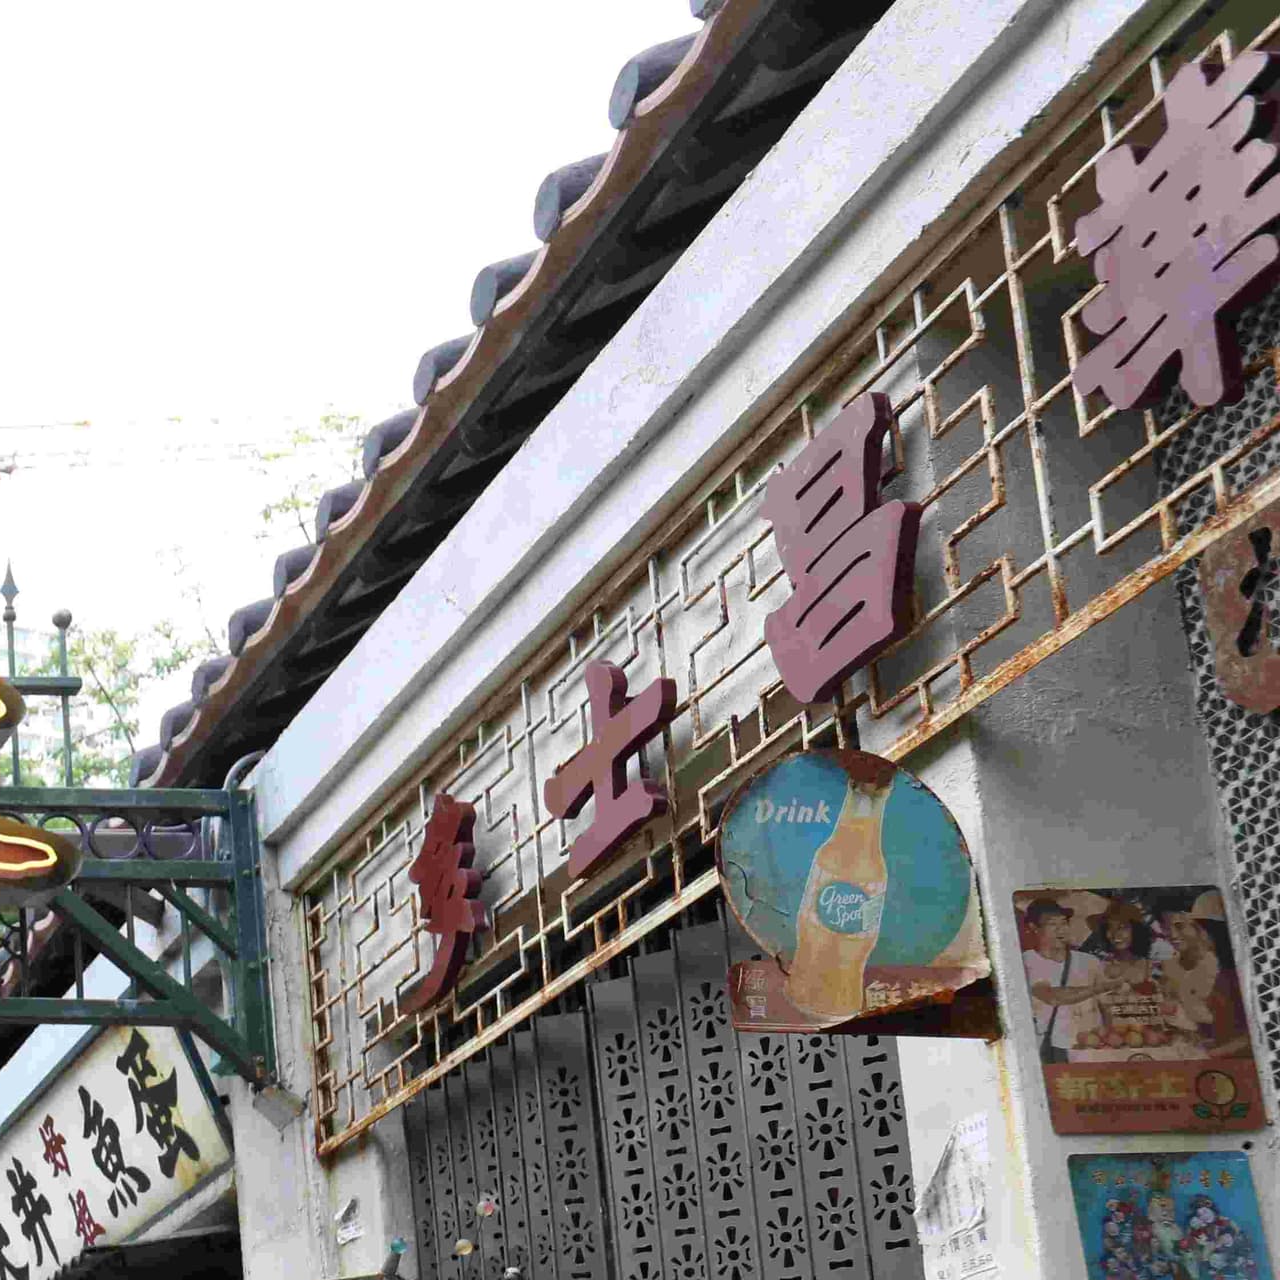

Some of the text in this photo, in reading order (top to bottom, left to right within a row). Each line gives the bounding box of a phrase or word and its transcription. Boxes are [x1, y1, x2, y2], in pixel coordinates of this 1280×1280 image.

[754, 798, 832, 825] Drink
[818, 885, 866, 914] Green
[831, 901, 868, 928] Spo
